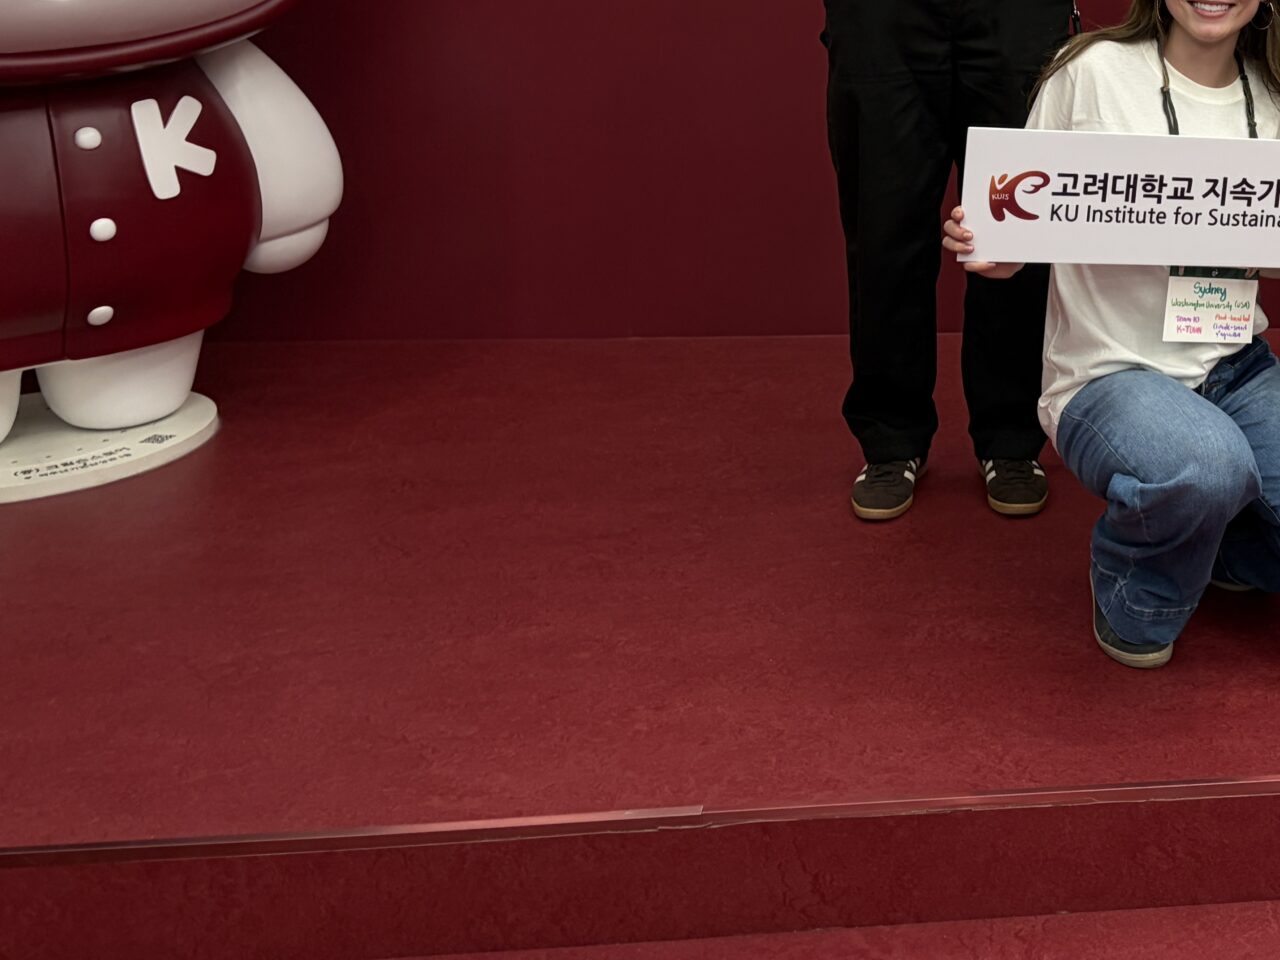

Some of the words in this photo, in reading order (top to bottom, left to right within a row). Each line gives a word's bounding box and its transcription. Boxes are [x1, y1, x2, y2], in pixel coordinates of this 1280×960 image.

[131, 95, 217, 200] K
[1051, 172, 1194, 204] 고려대학교
[1050, 204, 1079, 222] KU
[1086, 205, 1167, 224] Institute
[1173, 207, 1202, 226] for
[1193, 281, 1227, 302] Sydney
